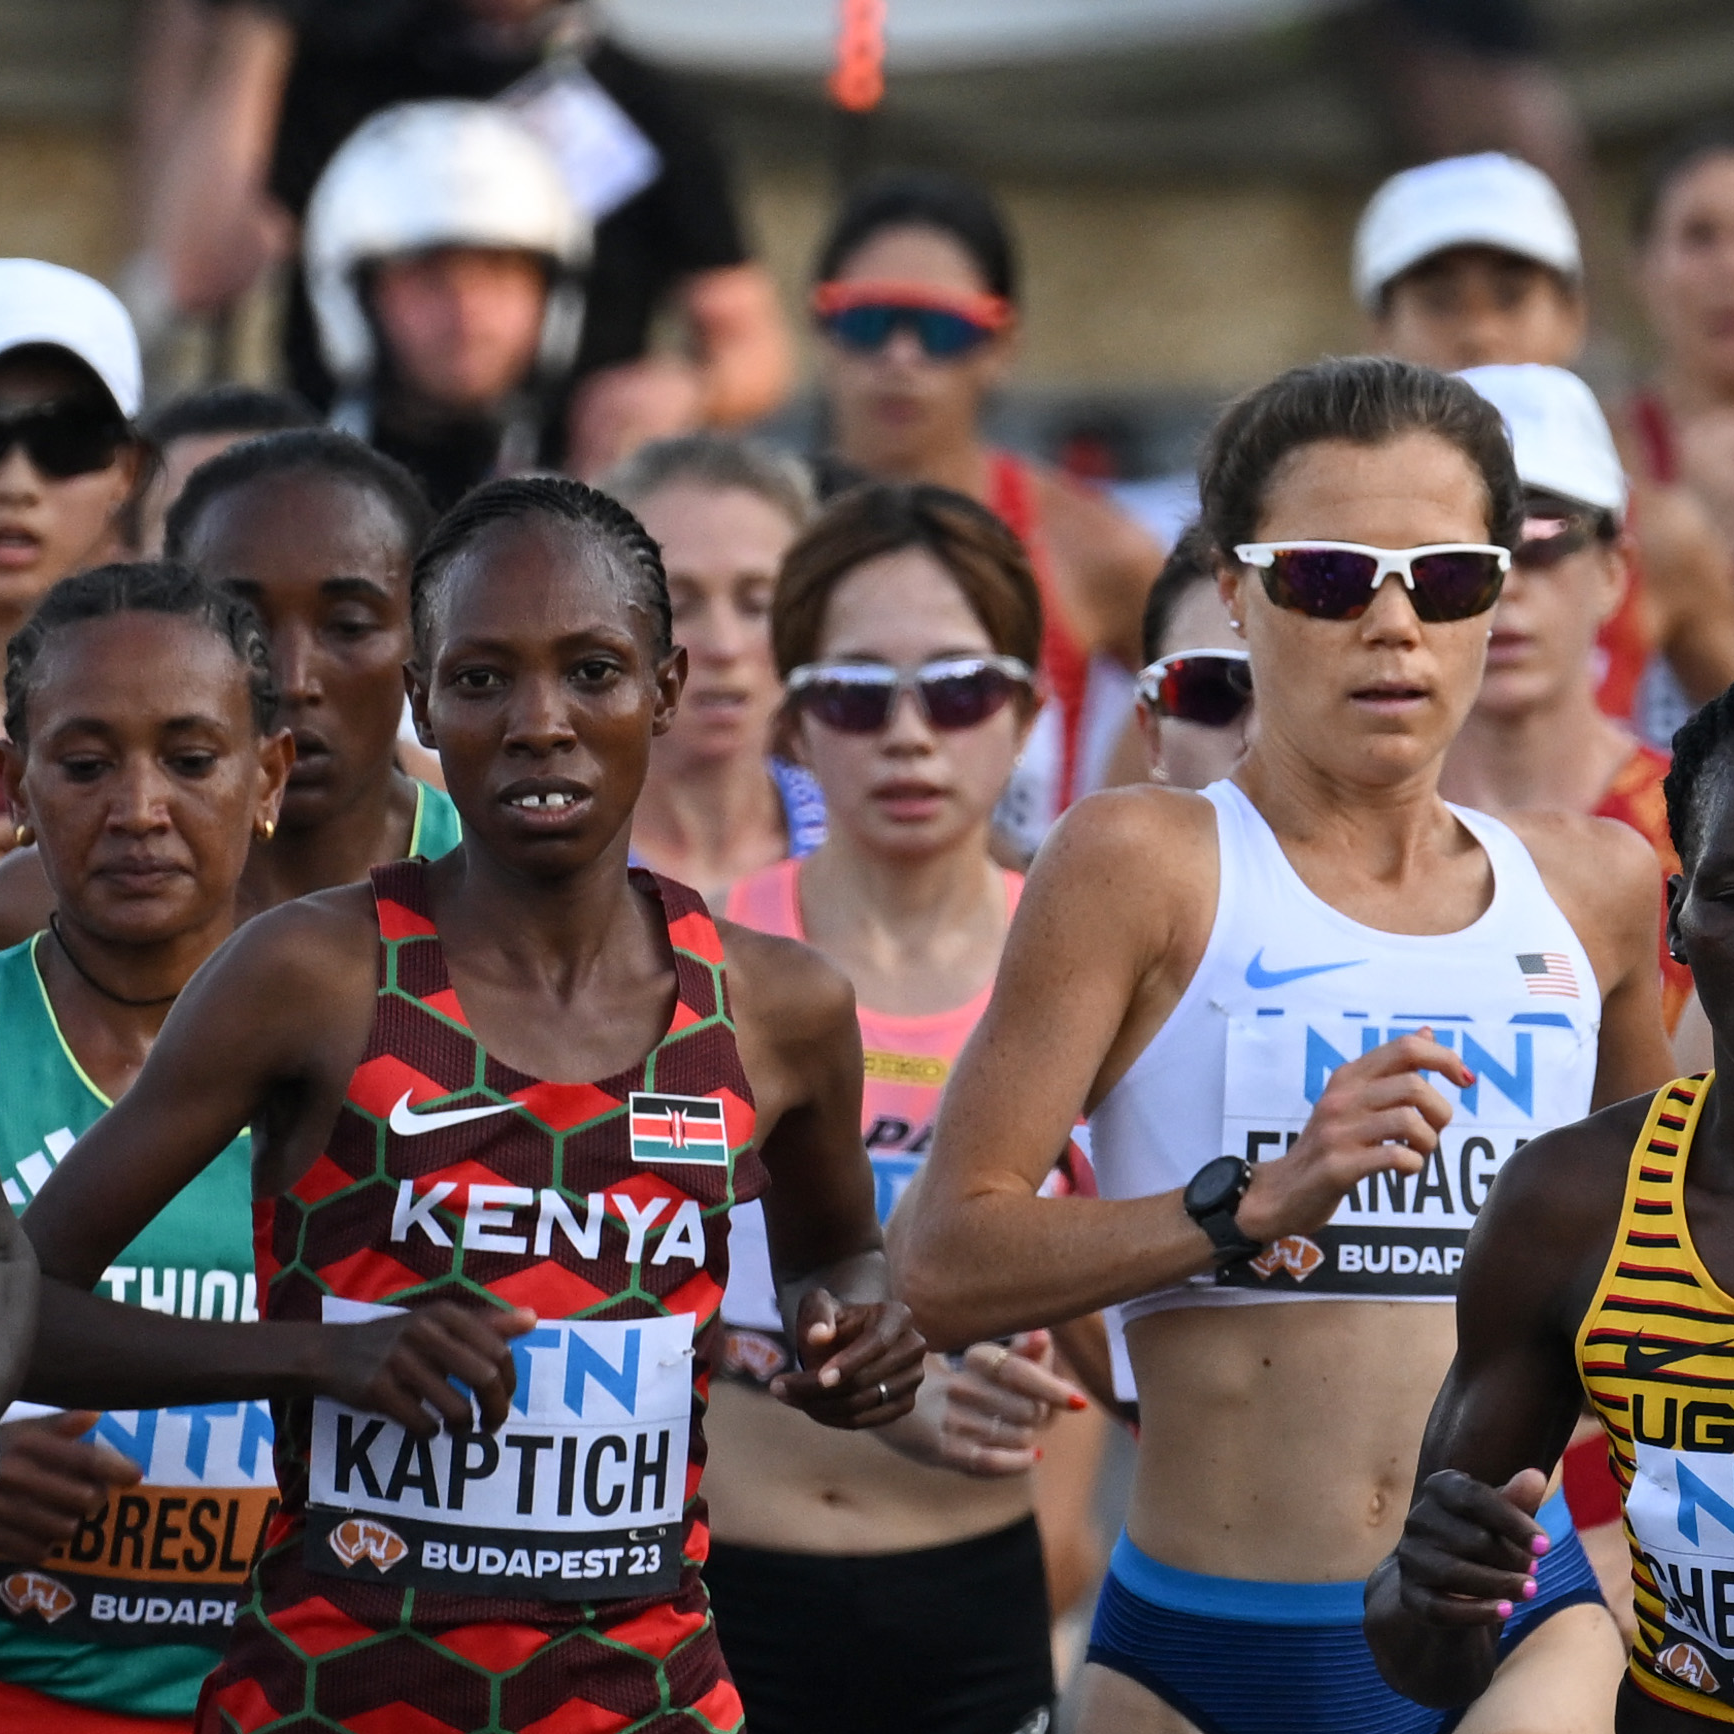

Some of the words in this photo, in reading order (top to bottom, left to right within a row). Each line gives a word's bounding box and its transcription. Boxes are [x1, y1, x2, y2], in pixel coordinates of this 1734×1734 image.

[391, 1179, 707, 1267] KENYA
[1338, 1244, 1465, 1275] BUDAP
[447, 1327, 641, 1419] TN
[333, 1413, 670, 1518] KAPTICH
[52, 1495, 282, 1573] BRESL
[421, 1540, 624, 1580] BUDAPEST
[627, 1545, 662, 1575] 23
[91, 1593, 237, 1626] BUDAPE
